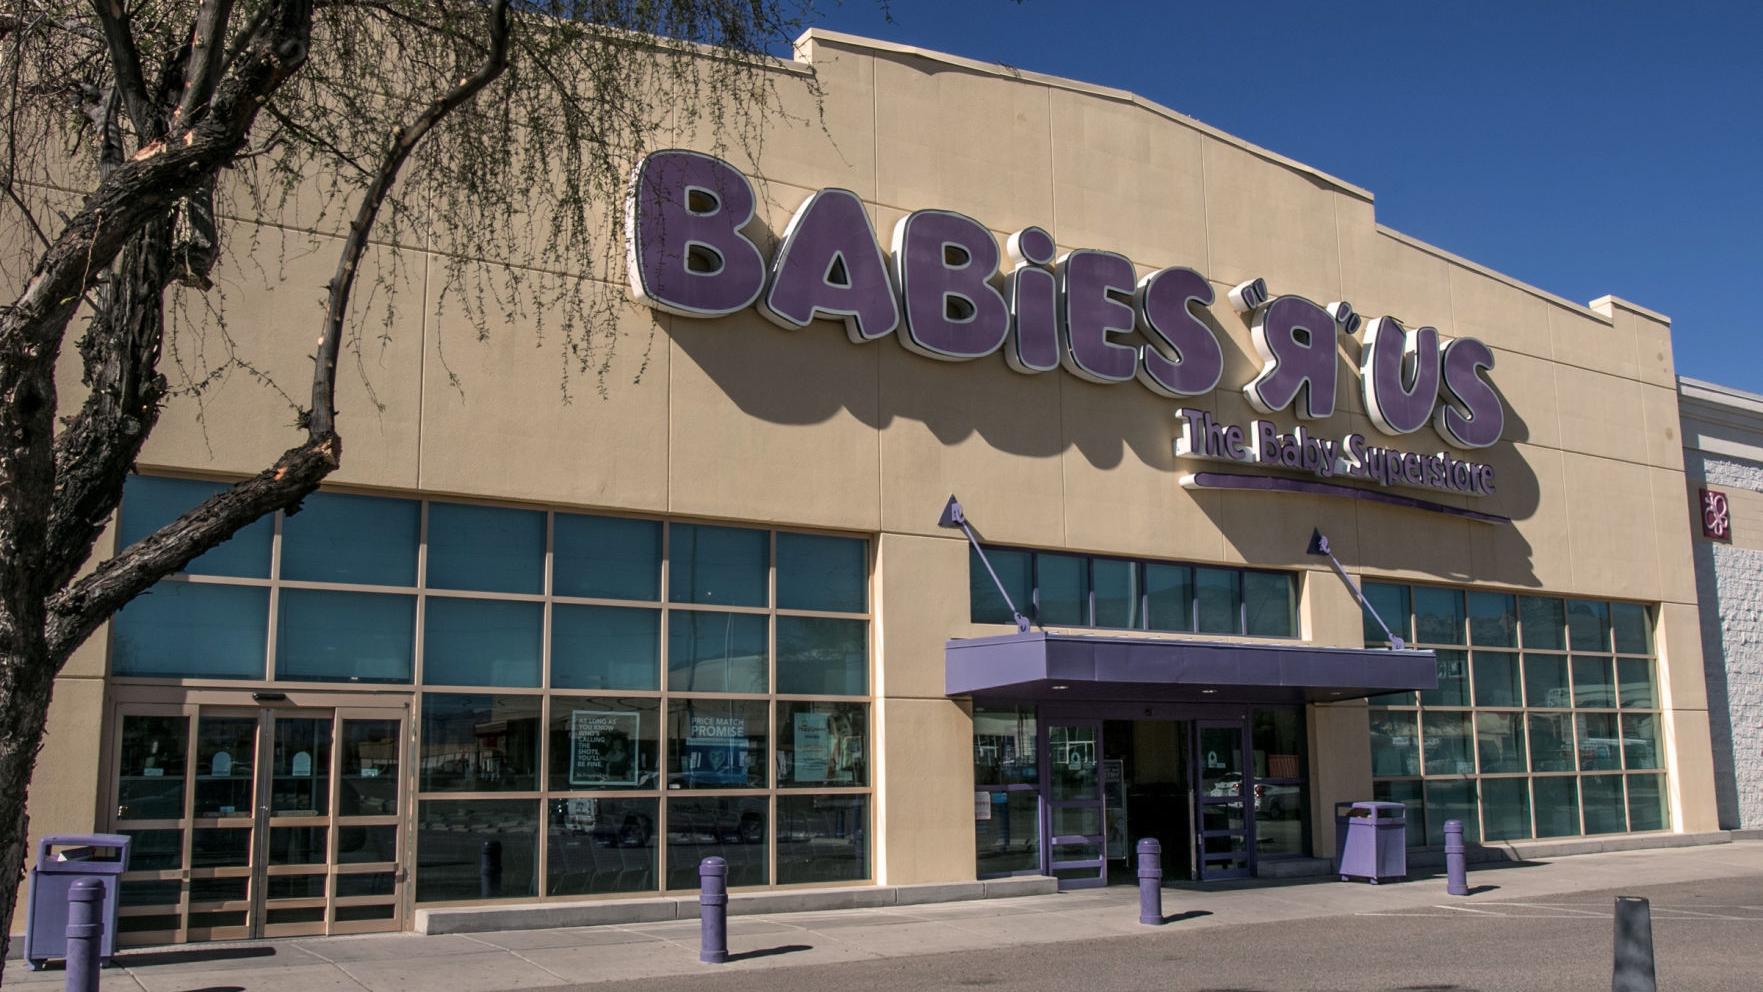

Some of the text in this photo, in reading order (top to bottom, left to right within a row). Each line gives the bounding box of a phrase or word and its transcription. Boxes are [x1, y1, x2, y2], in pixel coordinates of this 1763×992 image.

[1362, 316, 1504, 449] US
[1177, 408, 1496, 496] The Baby Superstore
[691, 716, 745, 727] PRICE MATCH
[691, 726, 745, 737] PROMISE
